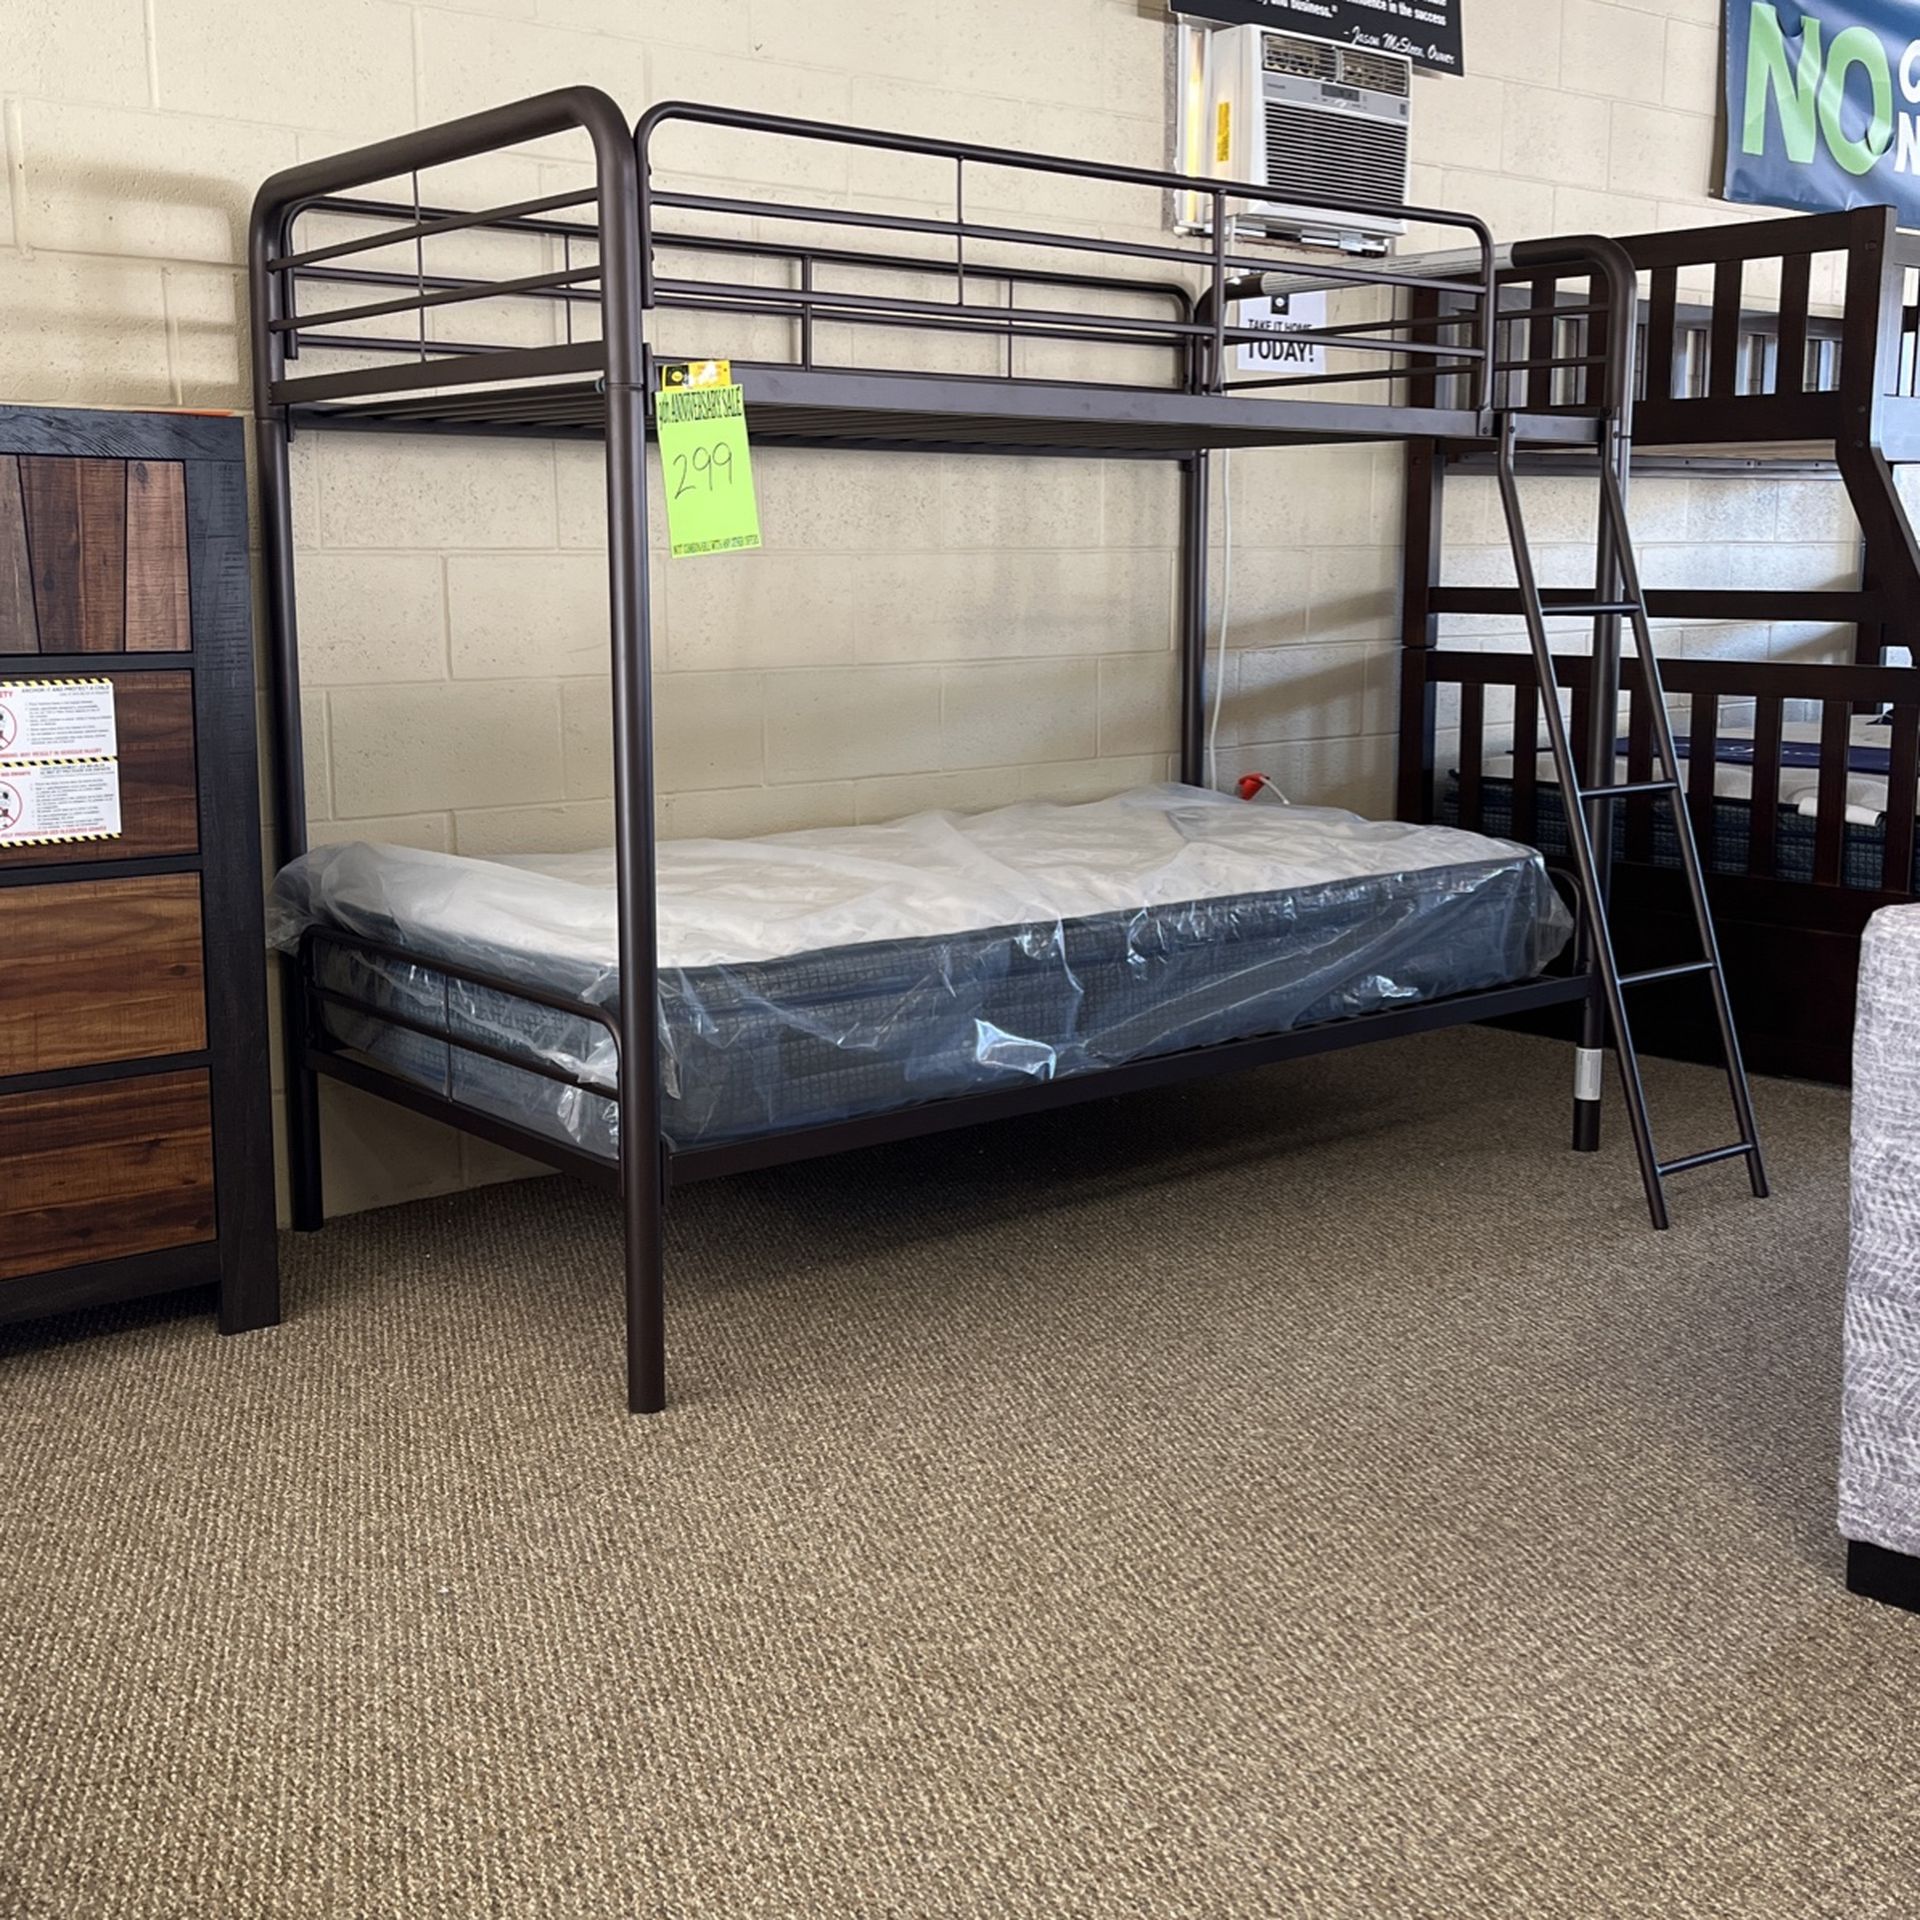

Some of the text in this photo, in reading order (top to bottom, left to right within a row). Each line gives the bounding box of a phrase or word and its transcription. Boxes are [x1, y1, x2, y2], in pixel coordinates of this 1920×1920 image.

[1388, 0, 1397, 13] in
[1399, 1, 1413, 17] the
[1414, 9, 1447, 26] success
[1743, 2, 1893, 176] NO
[1248, 340, 1314, 363] TODAY!
[672, 442, 732, 500] 299
